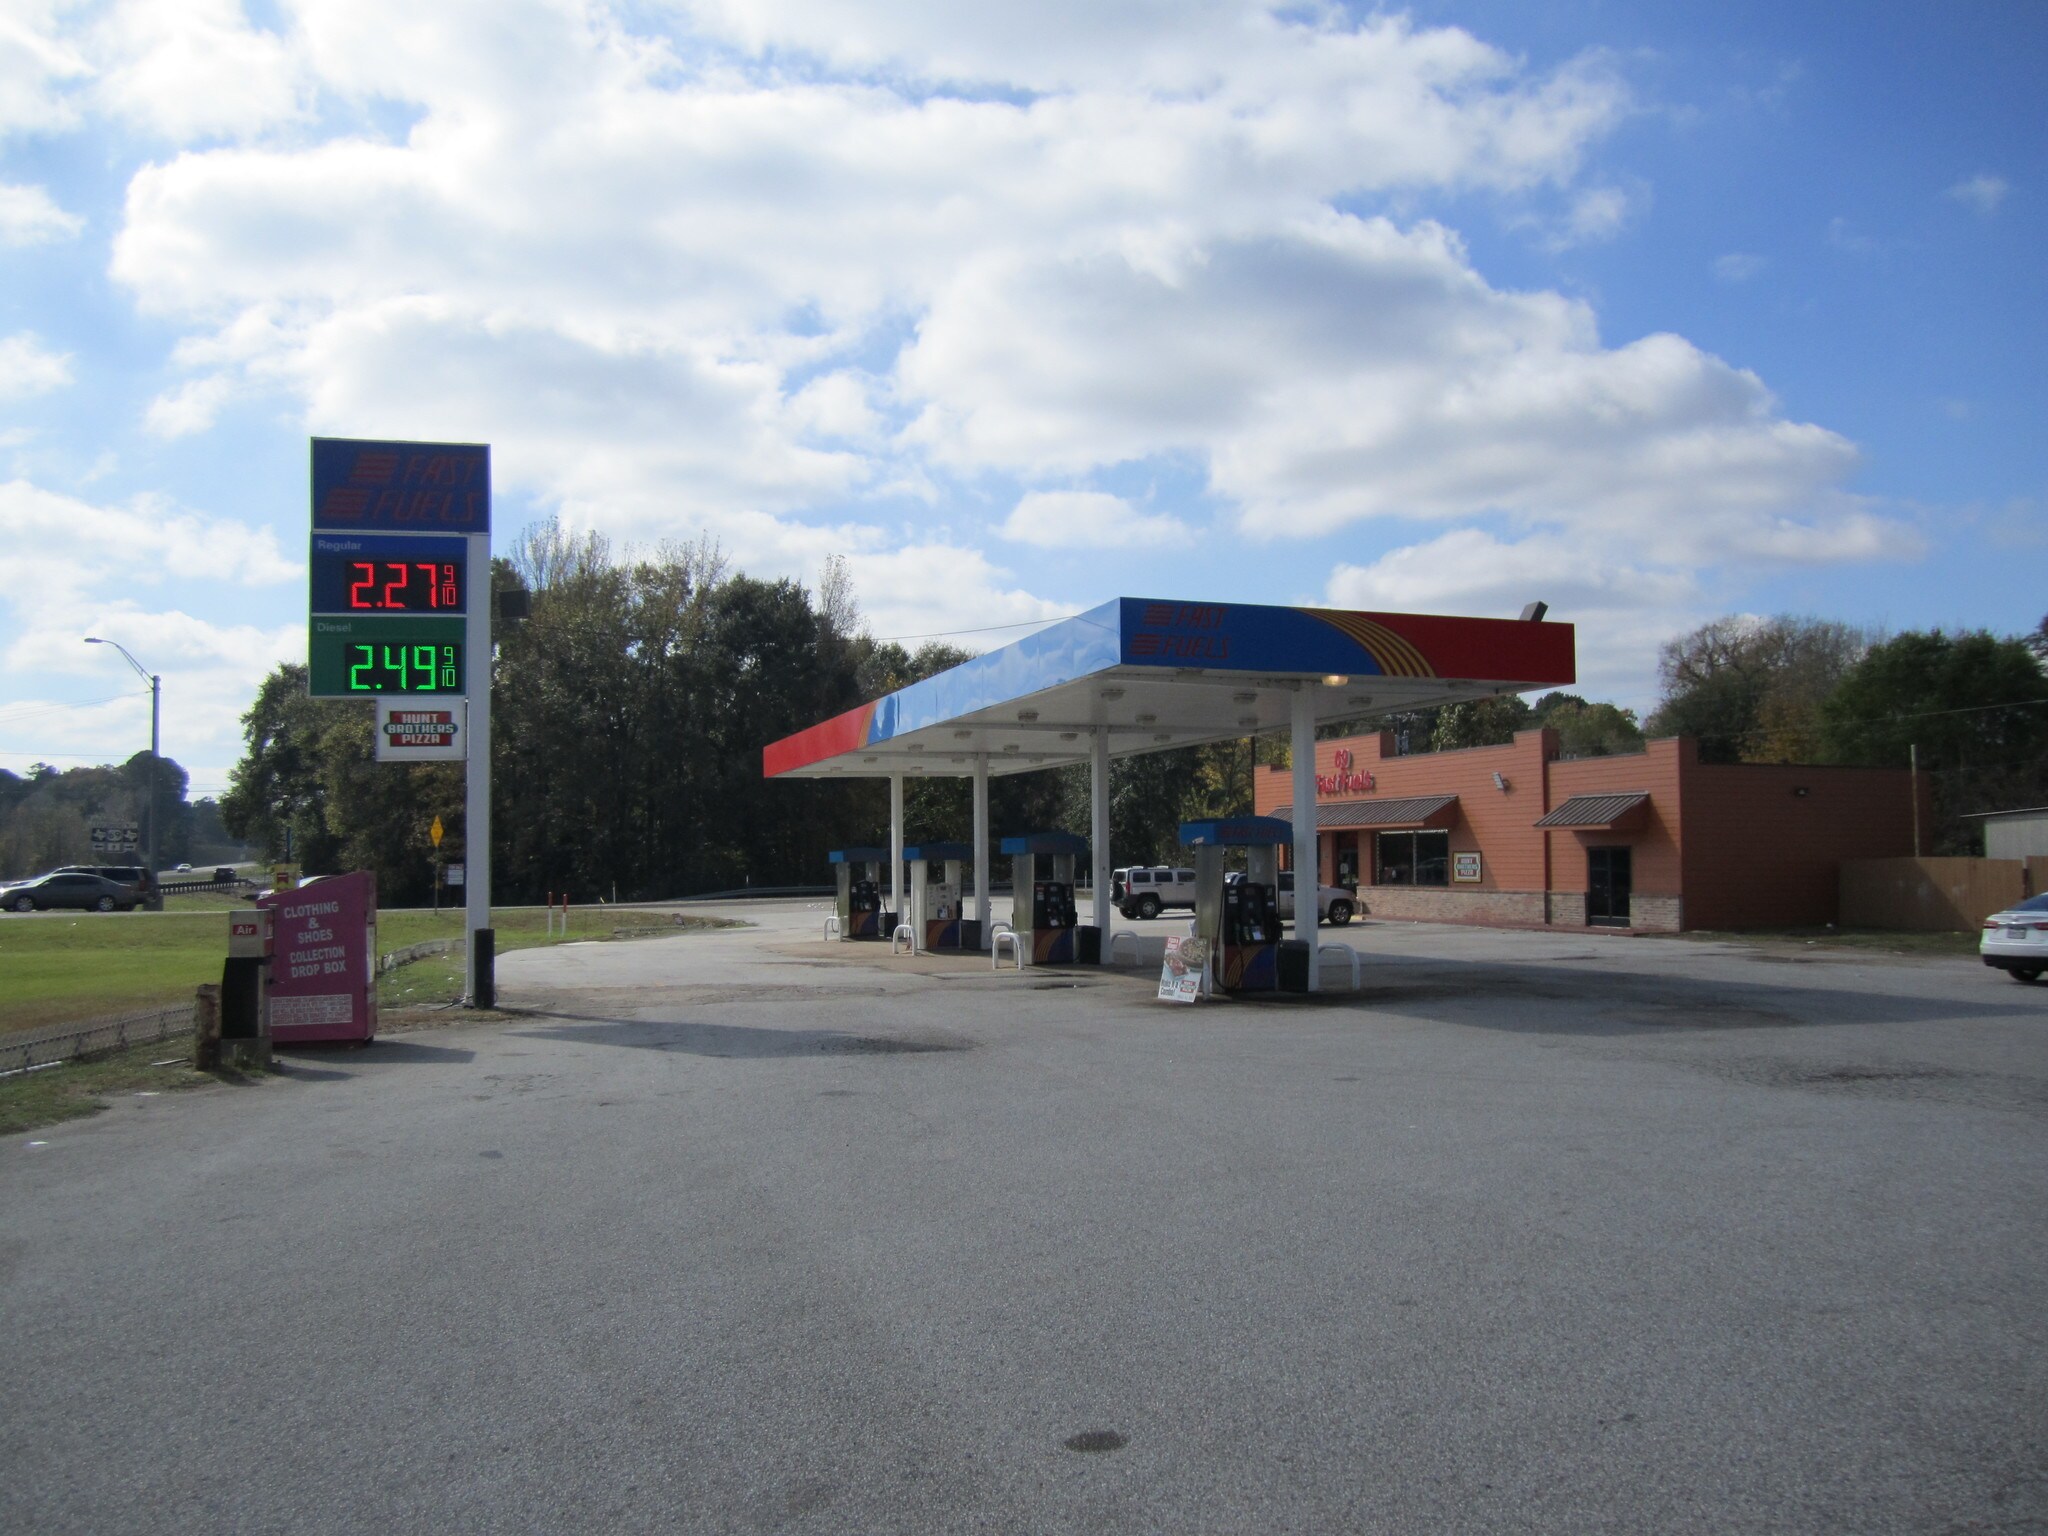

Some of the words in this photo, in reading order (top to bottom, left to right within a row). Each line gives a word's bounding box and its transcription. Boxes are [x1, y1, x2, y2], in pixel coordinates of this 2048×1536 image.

[403, 455, 485, 485] FAST
[372, 491, 483, 522] FUELS
[318, 540, 362, 552] Regular
[351, 563, 437, 608] 2.27
[1175, 605, 1230, 630] FAST
[317, 622, 352, 632] Diesel
[1162, 635, 1232, 660] FUELS
[351, 645, 436, 690] 2.49
[402, 714, 439, 724] HUNT
[387, 724, 454, 734] BROTHERS
[401, 734, 440, 744] PIZZA
[1335, 749, 1350, 769] 69
[284, 901, 339, 919] CLOTHING
[236, 925, 253, 935] Air
[308, 917, 320, 929] &
[298, 929, 333, 944] SHOES
[290, 946, 345, 963] COLLECTION
[291, 964, 320, 978] DROP
[324, 960, 346, 974] BOX
